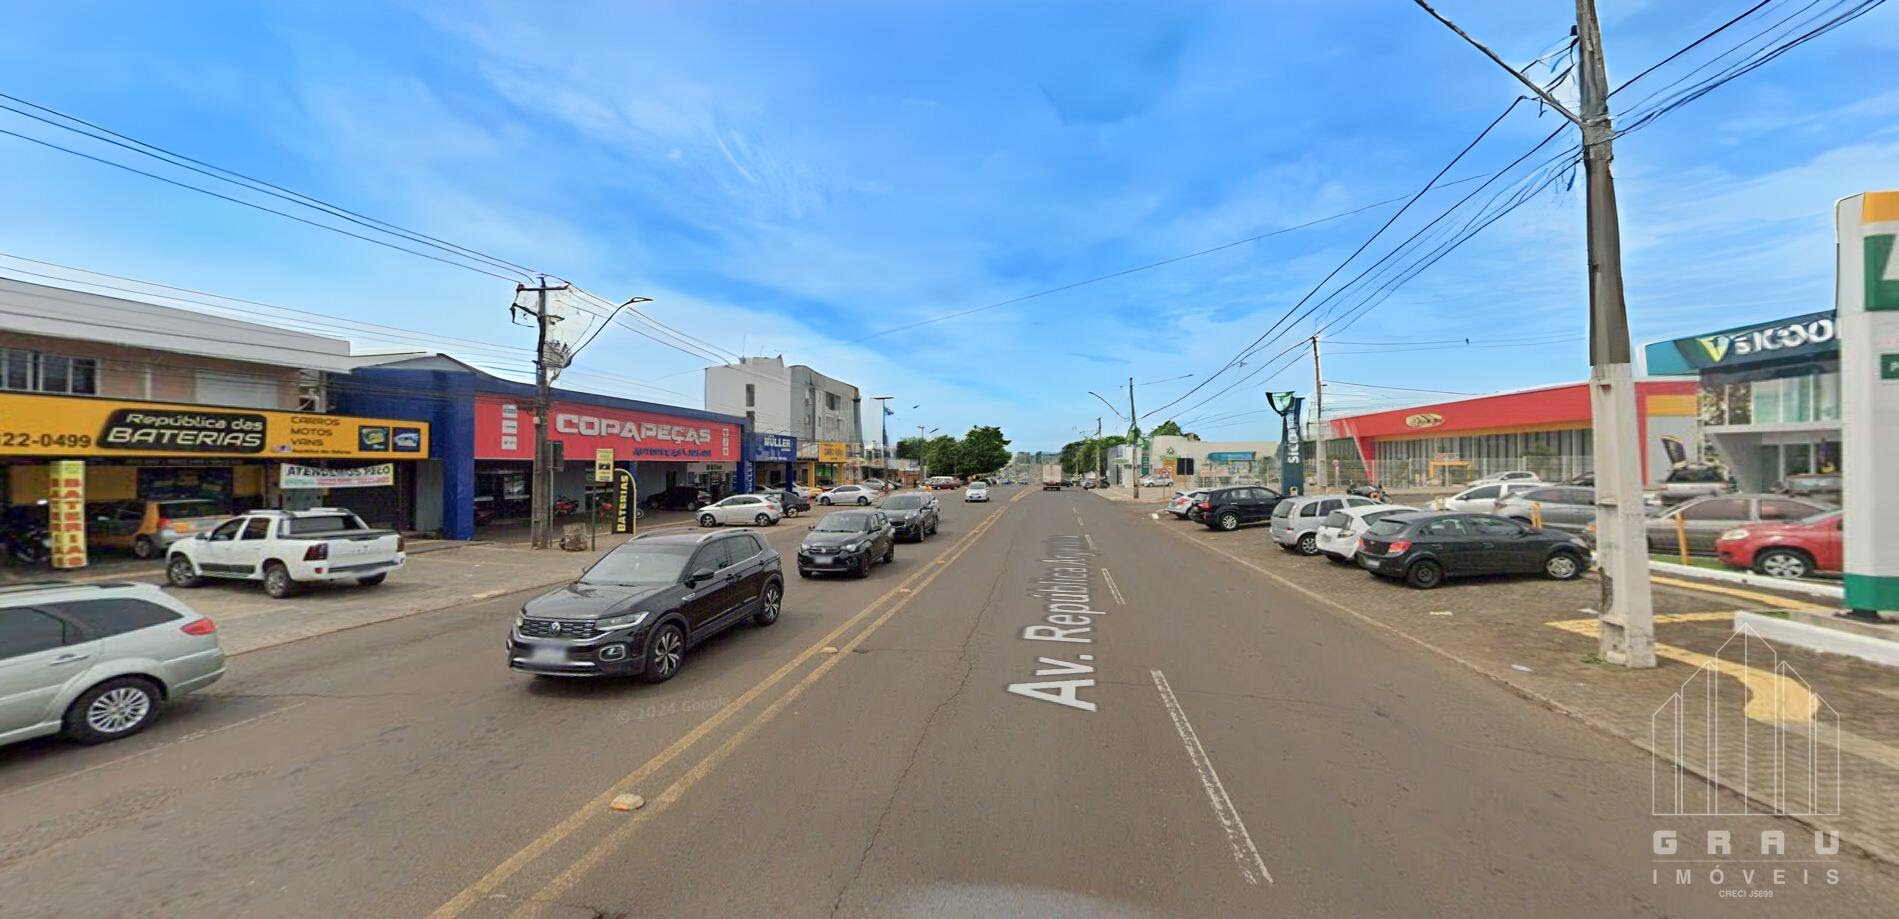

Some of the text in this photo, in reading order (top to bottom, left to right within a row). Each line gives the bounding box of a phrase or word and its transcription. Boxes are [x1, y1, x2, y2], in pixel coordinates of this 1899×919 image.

[1735, 319, 1836, 355] SICOO
[126, 414, 263, 430] República das
[290, 416, 341, 426] CARROS
[556, 413, 712, 445] COPAPEÇAS
[107, 427, 263, 447] BATERIAS
[290, 428, 333, 436] MOTOS
[290, 438, 324, 446] VANS
[617, 475, 629, 532] BATERIAS
